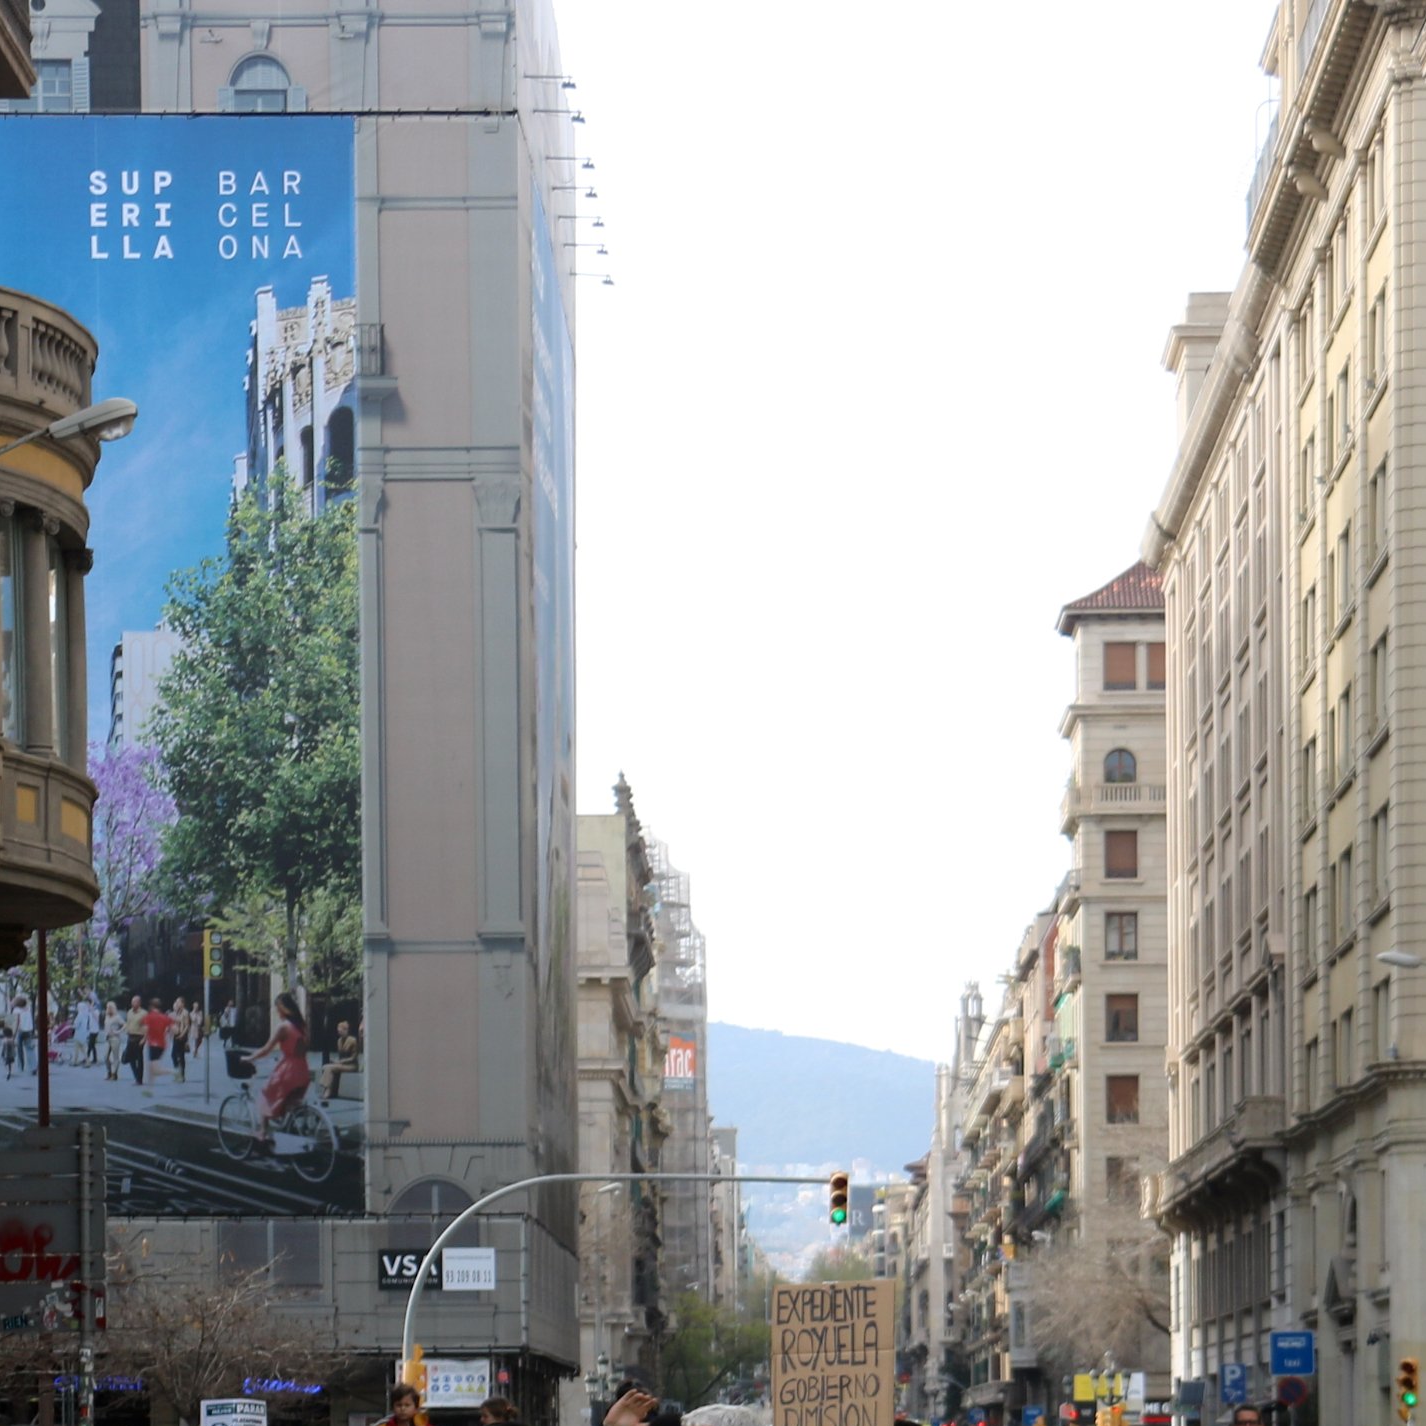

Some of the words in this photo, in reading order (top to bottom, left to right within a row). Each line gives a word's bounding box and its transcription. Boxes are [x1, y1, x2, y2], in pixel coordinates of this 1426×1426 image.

[88, 170, 172, 195] SUP
[218, 170, 302, 195] BAR
[90, 203, 172, 227] ERI
[218, 203, 302, 227] CEL
[91, 235, 174, 260] LLA
[218, 235, 303, 260] ONA
[781, 1320, 879, 1374] ROYUELA
